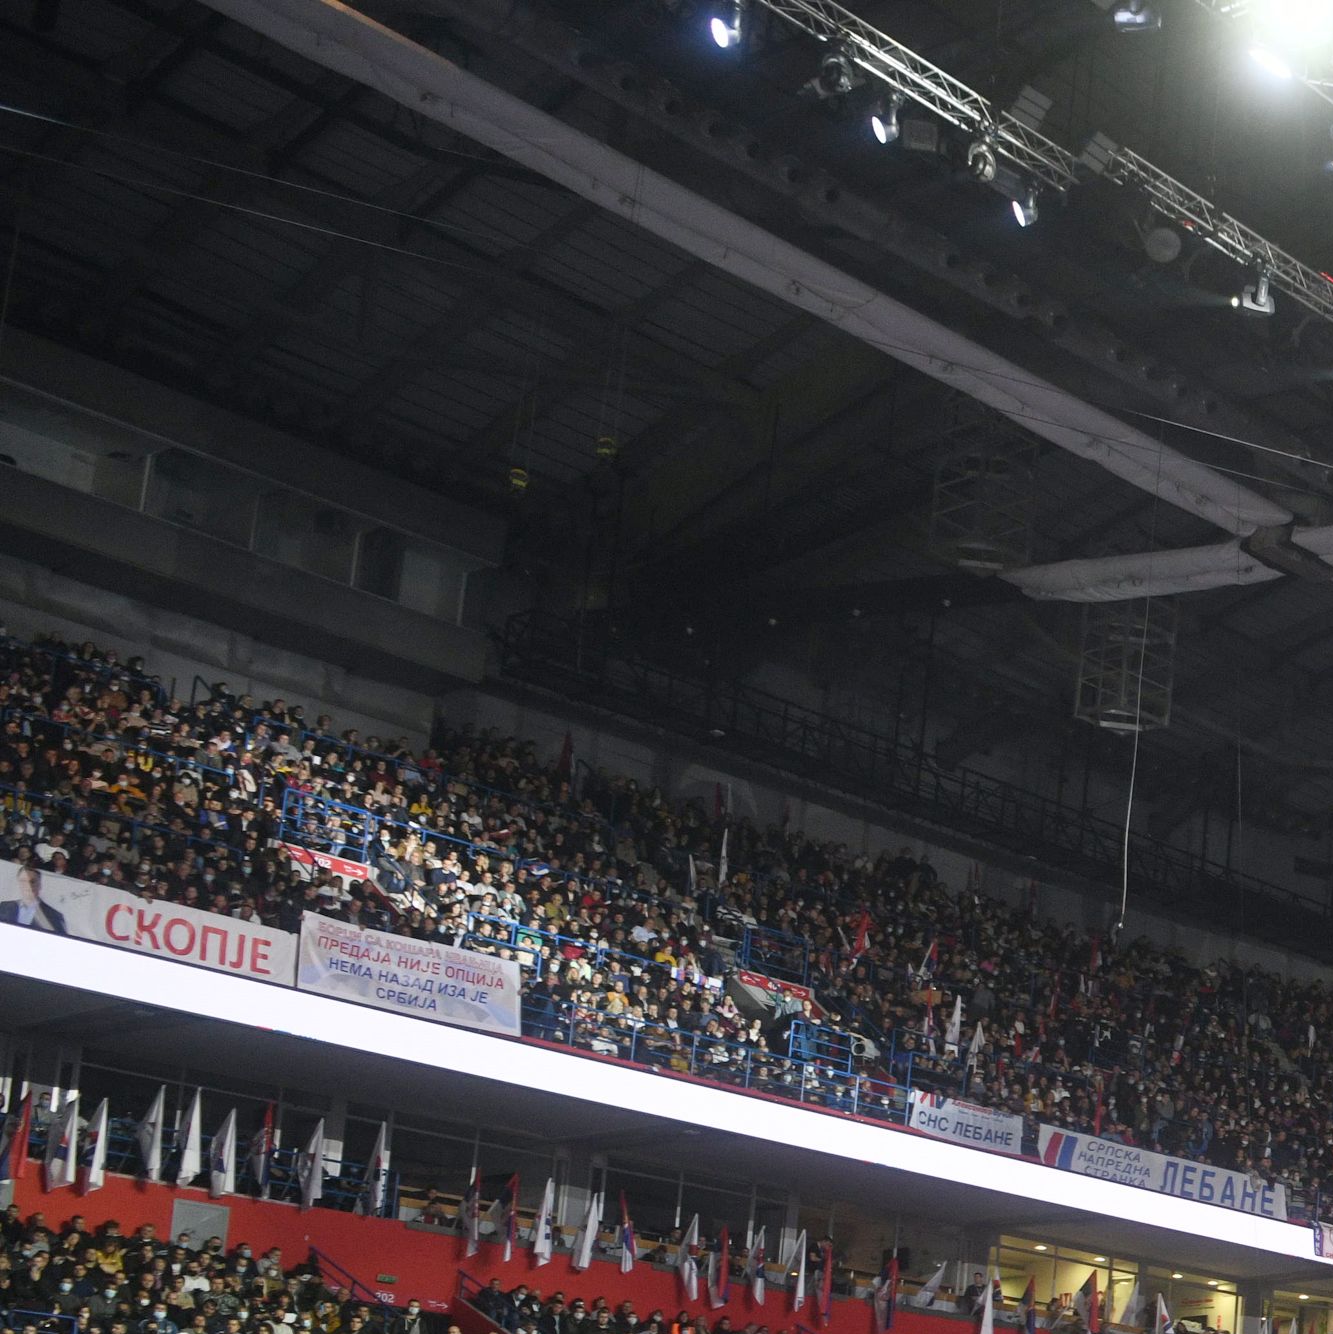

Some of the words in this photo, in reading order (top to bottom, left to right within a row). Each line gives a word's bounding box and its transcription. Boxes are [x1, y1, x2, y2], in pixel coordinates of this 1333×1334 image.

[105, 903, 272, 975] СКОПЈЕ
[318, 936, 391, 966] ПРЕДАЈА
[397, 956, 441, 975] НИЈЕ
[445, 965, 504, 990] ОПЦИЈА
[329, 957, 373, 979] НЕМА
[378, 971, 433, 994] НАЗАД
[437, 981, 468, 999] ИЗА
[470, 989, 489, 1004] ЈЕ
[376, 987, 437, 1012] СРБИЈА
[918, 1110, 949, 1132] СНС
[952, 1121, 1013, 1146] ЛЕБАНЕ
[1077, 1151, 1151, 1178] НАПРЕДНА
[1087, 1141, 1141, 1163] СРПСКА
[1160, 1161, 1275, 1216] ЛЕБАНЕ
